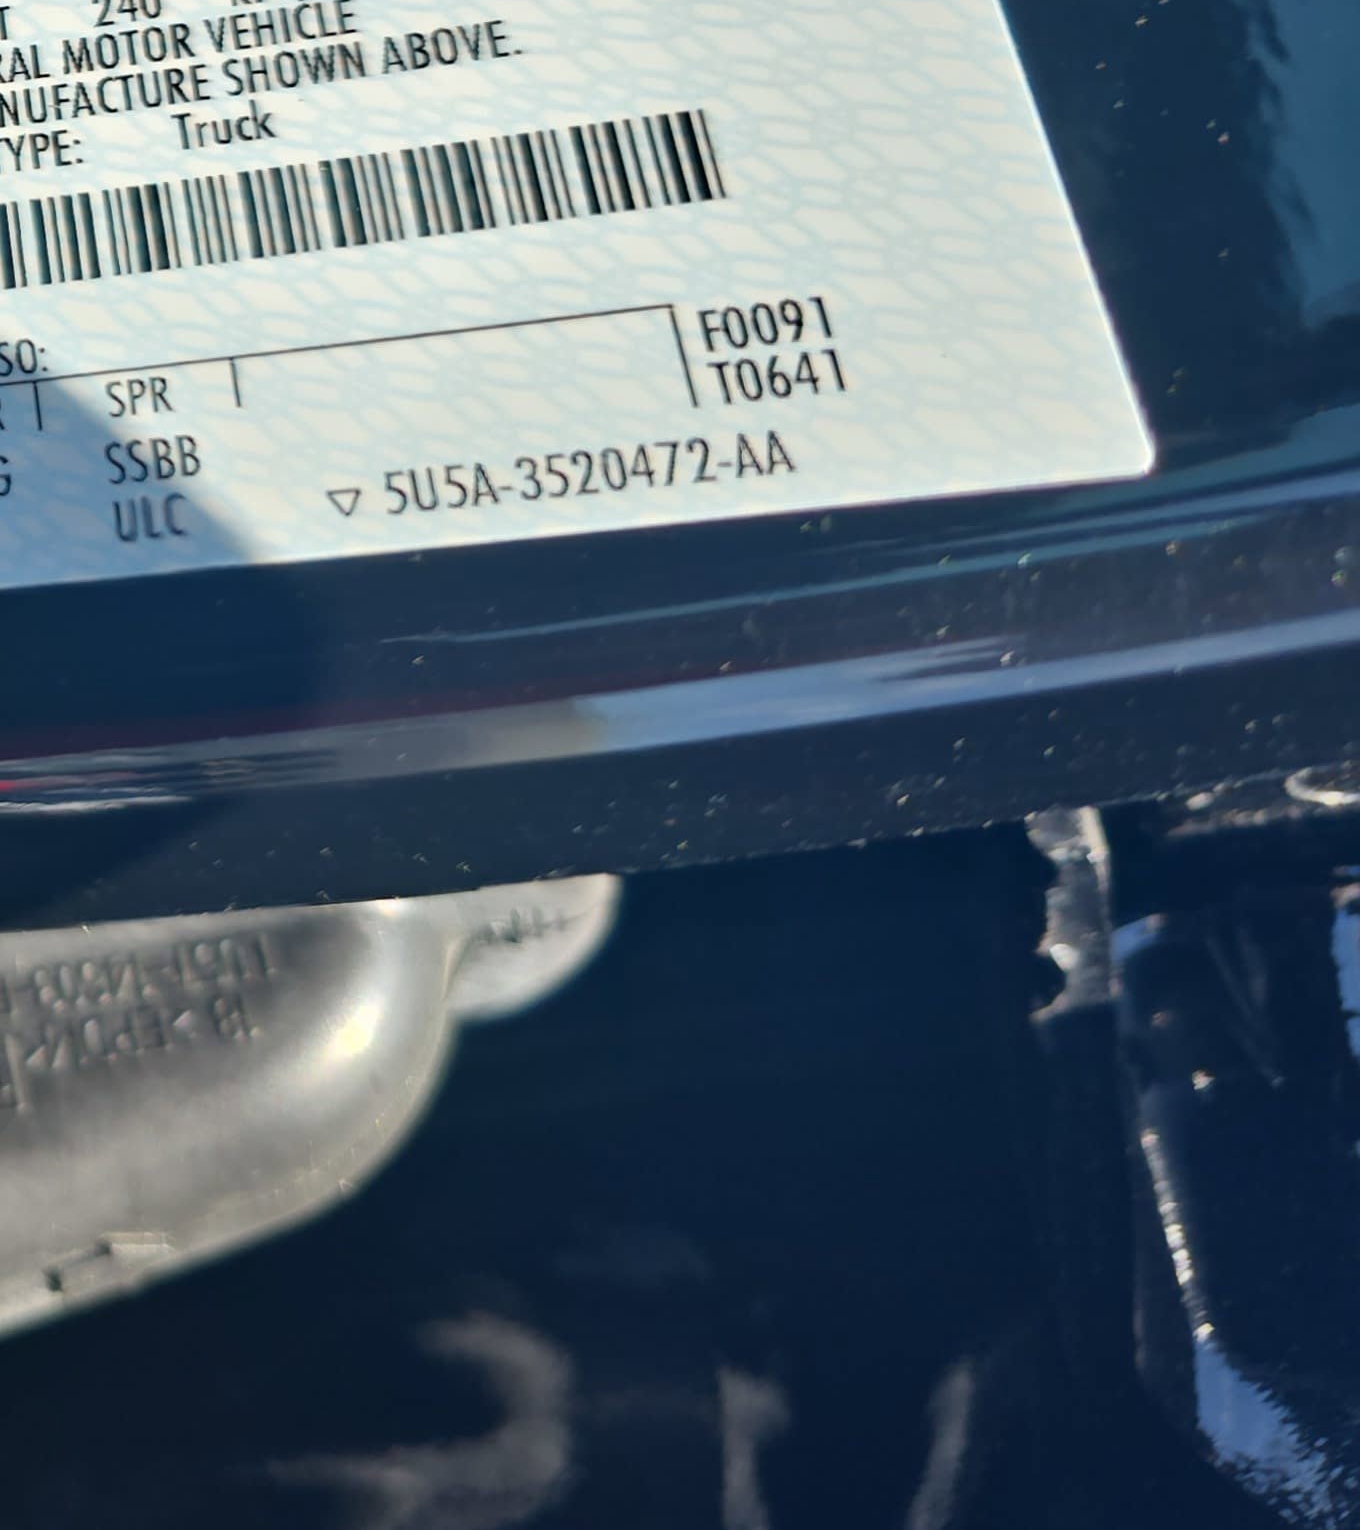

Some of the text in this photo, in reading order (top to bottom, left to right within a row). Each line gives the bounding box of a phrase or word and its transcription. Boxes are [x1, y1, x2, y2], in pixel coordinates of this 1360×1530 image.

[62, 22, 195, 75] MOTOR
[221, 40, 367, 96] SHOWN
[381, 19, 523, 75] ABOVE.
[172, 100, 278, 150] Truck
[694, 295, 836, 354] F0091
[105, 376, 175, 419] SPR
[708, 348, 848, 406] T0641
[103, 434, 203, 486] SSBB
[381, 429, 797, 516] 5U5A-3520472-AA
[112, 492, 188, 544] ULC
